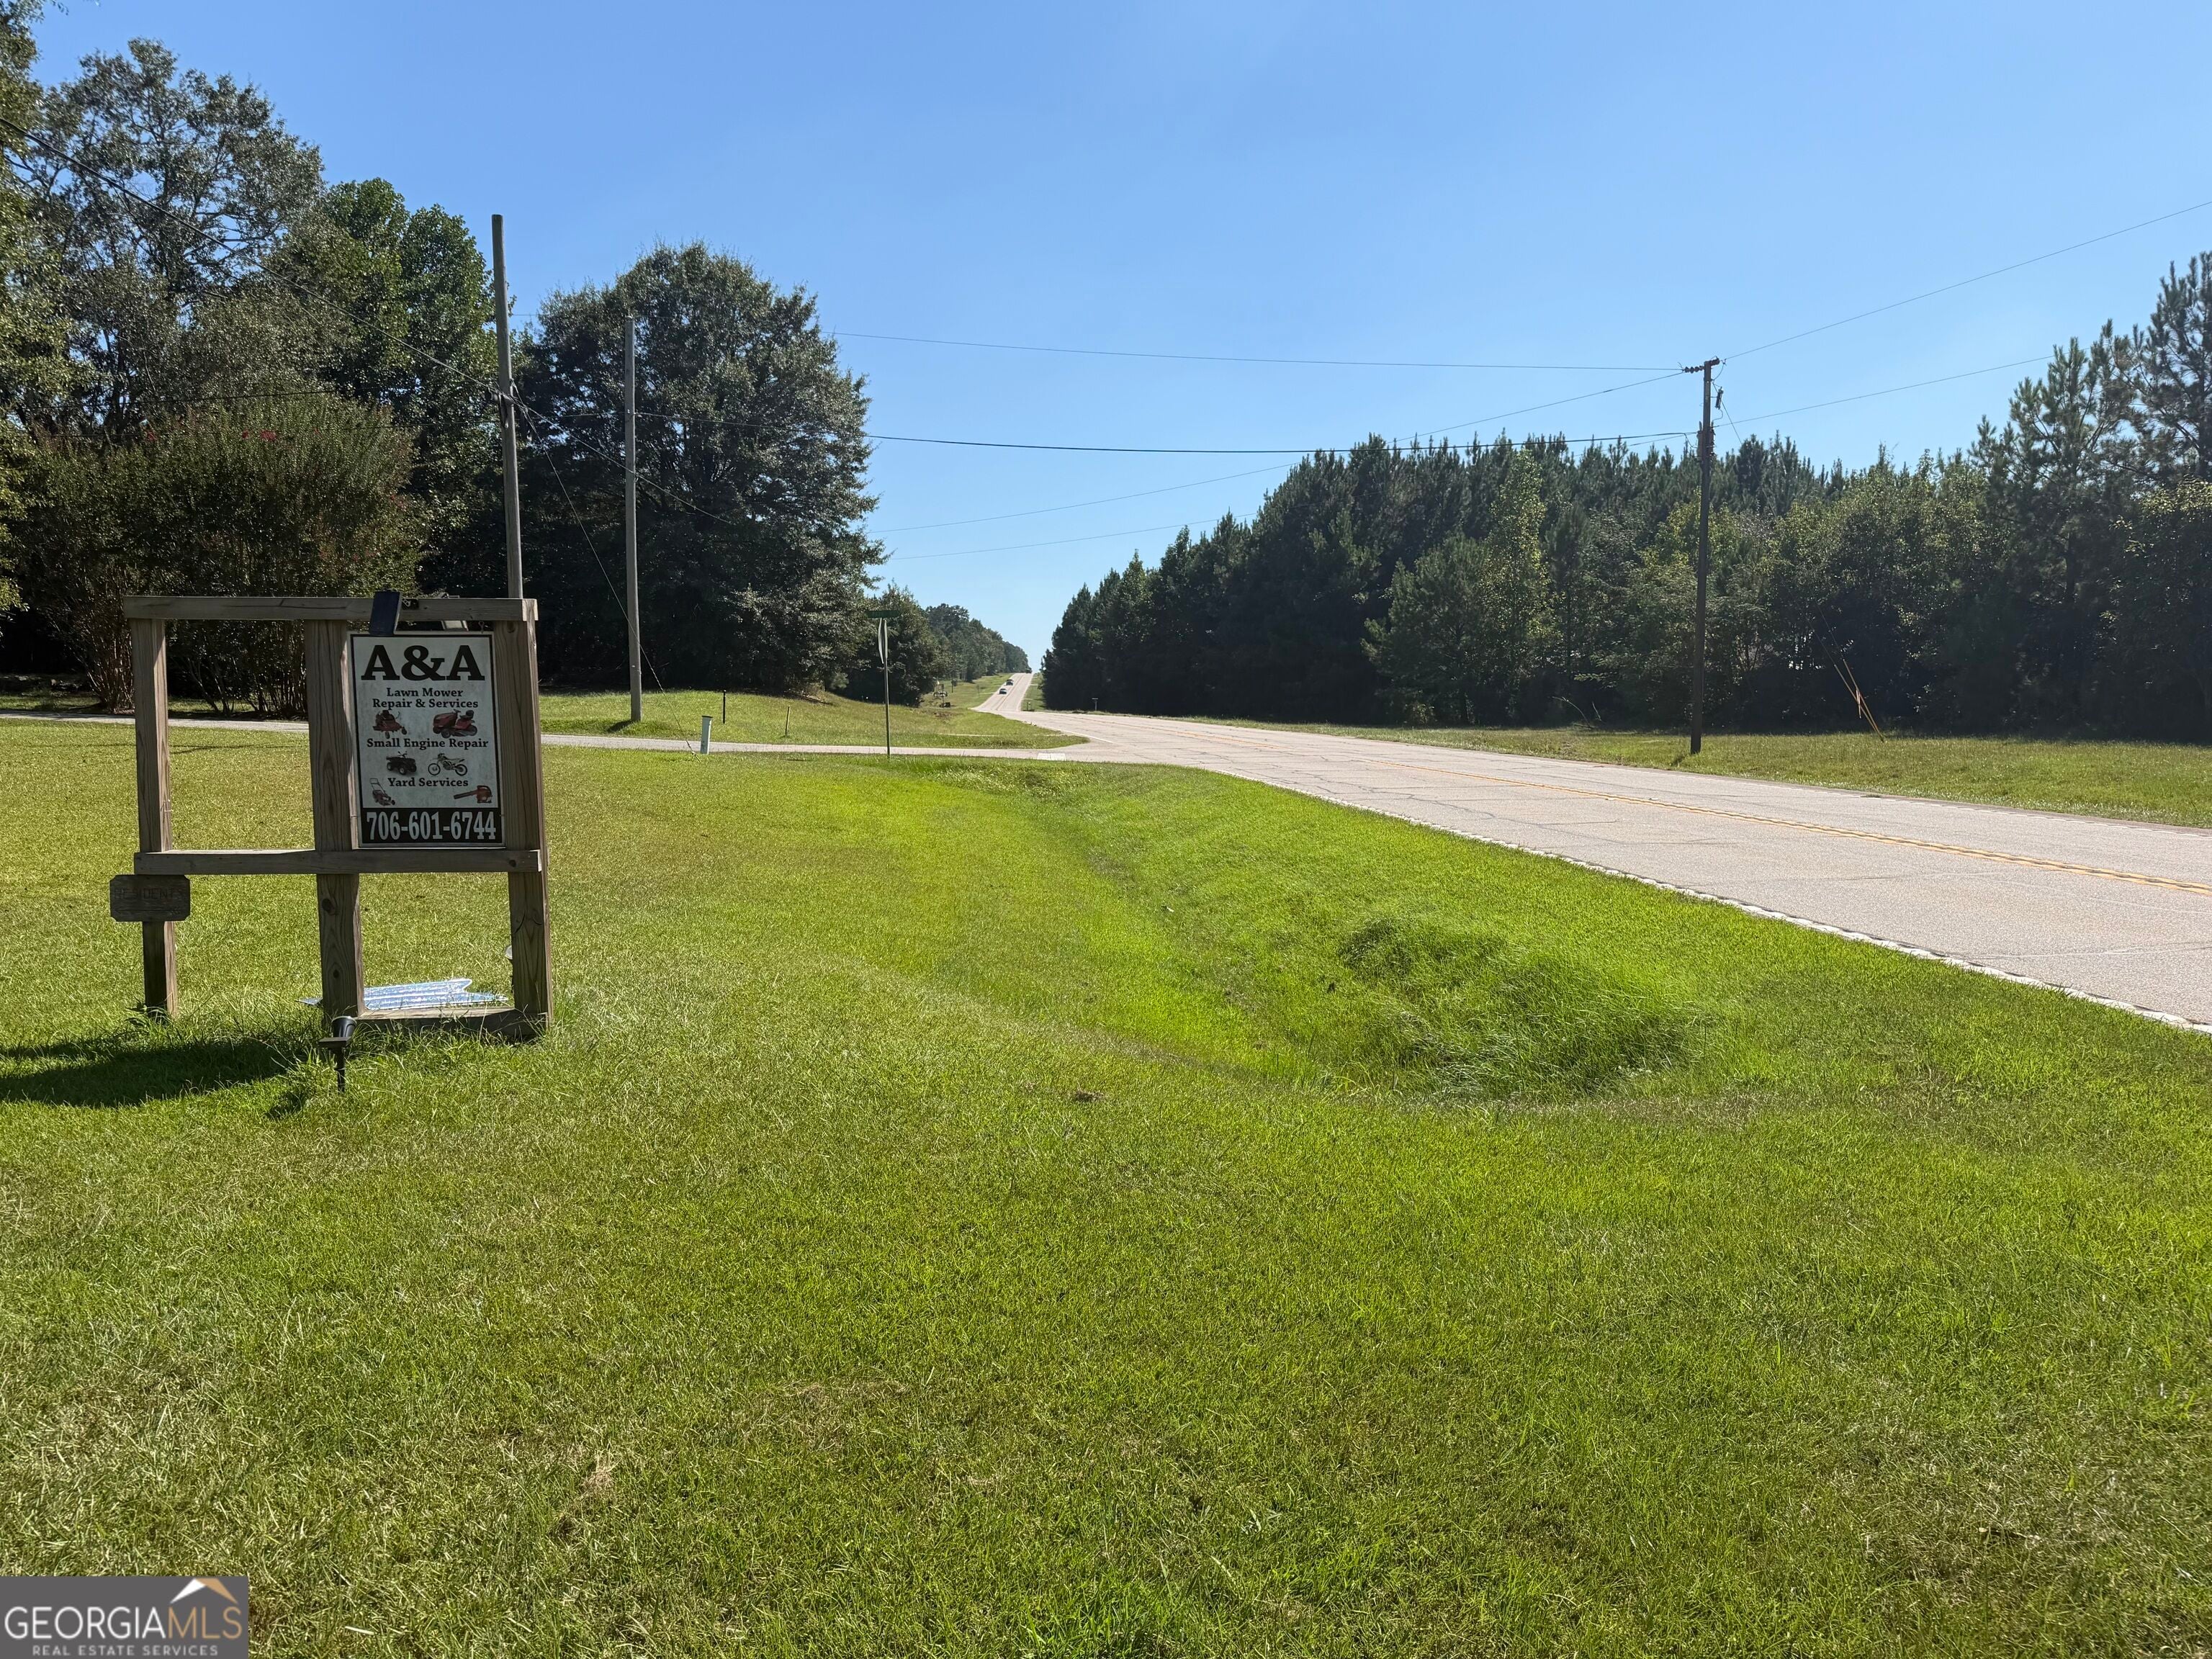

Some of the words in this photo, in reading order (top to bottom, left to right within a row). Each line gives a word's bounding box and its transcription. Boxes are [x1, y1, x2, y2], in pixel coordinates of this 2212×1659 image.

[361, 644, 485, 681] A&A
[387, 688, 420, 698] Lawn
[422, 688, 464, 698] Mower
[372, 698, 414, 710] Repair
[415, 699, 426, 709] &
[428, 698, 479, 709] Services
[367, 738, 400, 748] Small
[403, 738, 446, 751] Engine
[449, 738, 489, 750] Repair
[387, 778, 415, 787] Yard
[418, 778, 469, 787] Services
[367, 811, 497, 840] 706-601-6744
